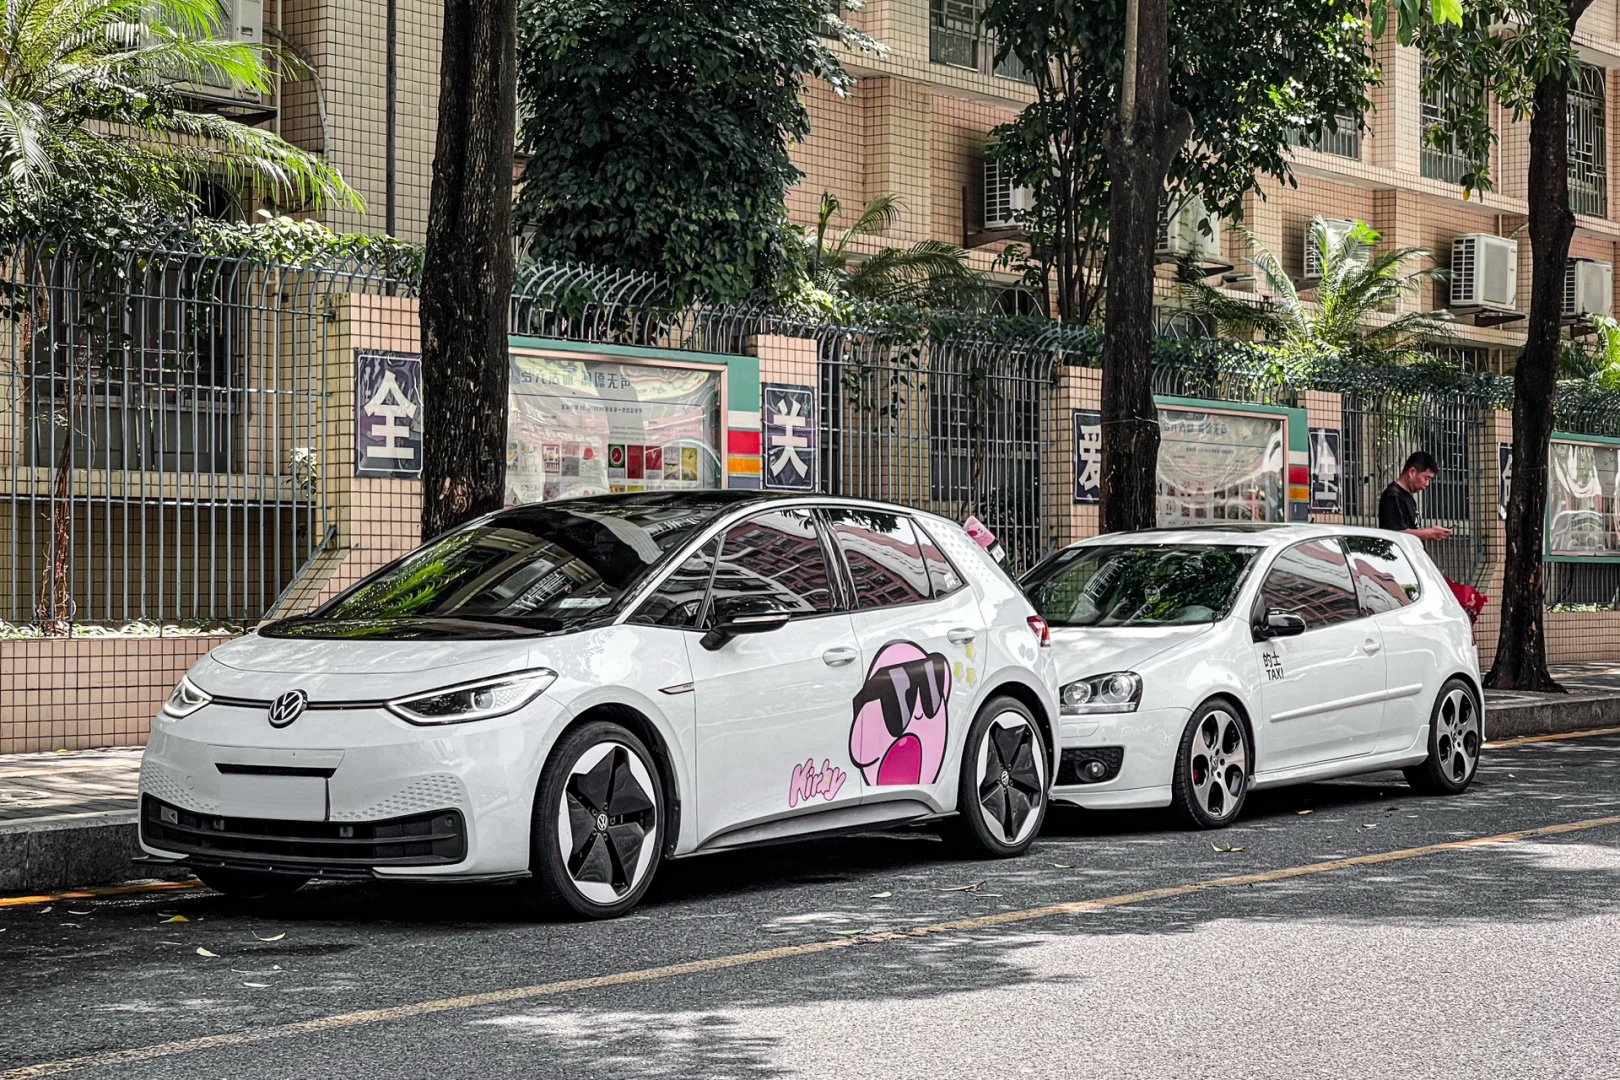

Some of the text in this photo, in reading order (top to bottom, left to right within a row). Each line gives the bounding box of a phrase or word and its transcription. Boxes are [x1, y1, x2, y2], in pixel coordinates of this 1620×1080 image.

[364, 370, 417, 459] 全
[771, 399, 808, 479] 关
[1263, 651, 1281, 668] 的士
[789, 758, 846, 807] Kirby
